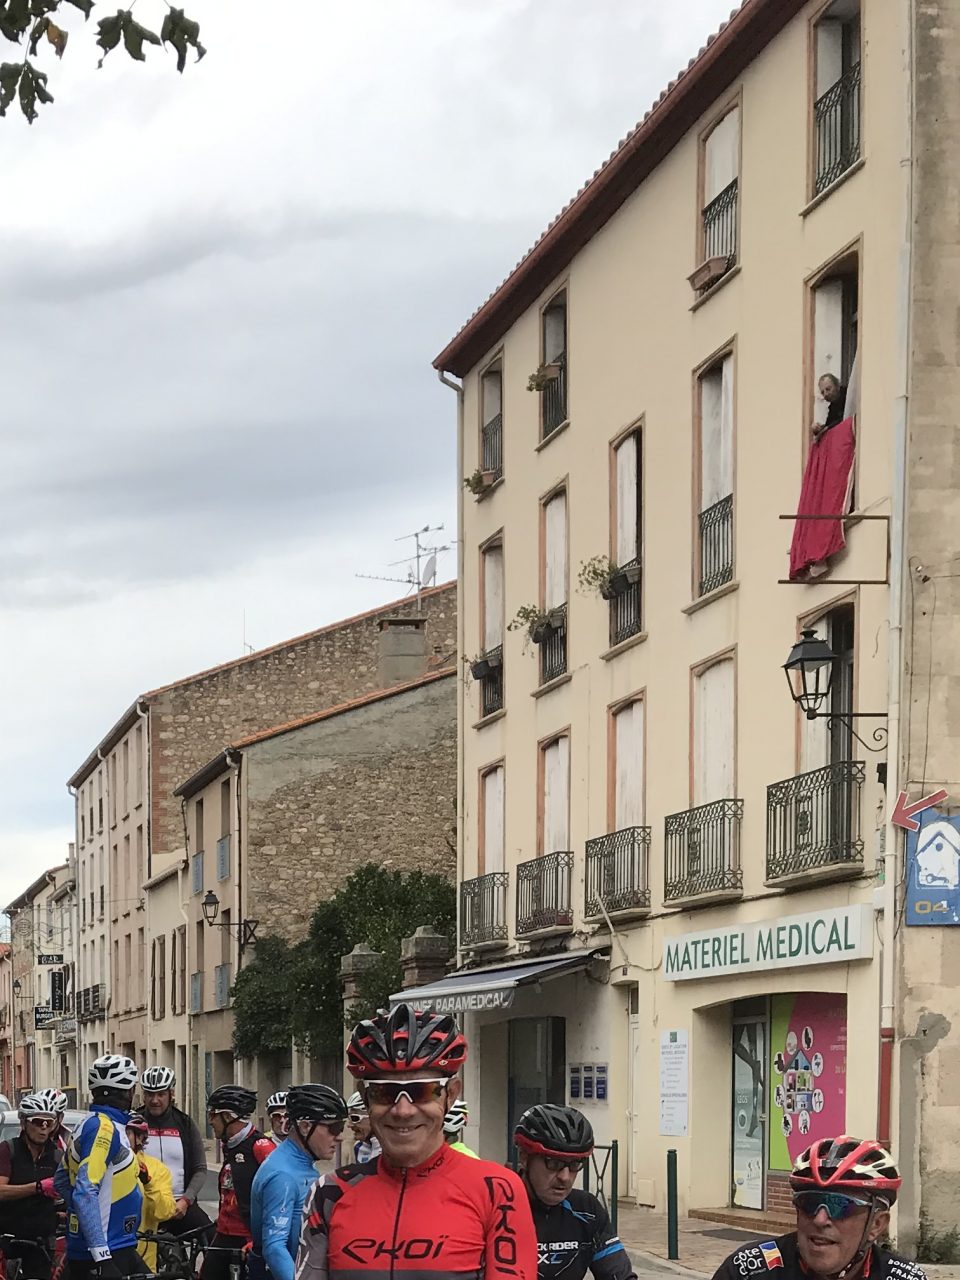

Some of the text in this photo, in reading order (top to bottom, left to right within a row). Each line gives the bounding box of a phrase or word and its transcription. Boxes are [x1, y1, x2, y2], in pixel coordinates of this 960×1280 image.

[665, 915, 856, 973] MATERIEL MEDICAL
[435, 992, 509, 1011] PARAMEDICAL
[548, 1241, 579, 1251] RIDER
[733, 1247, 760, 1265] Côte
[739, 1257, 763, 1276] d'Or
